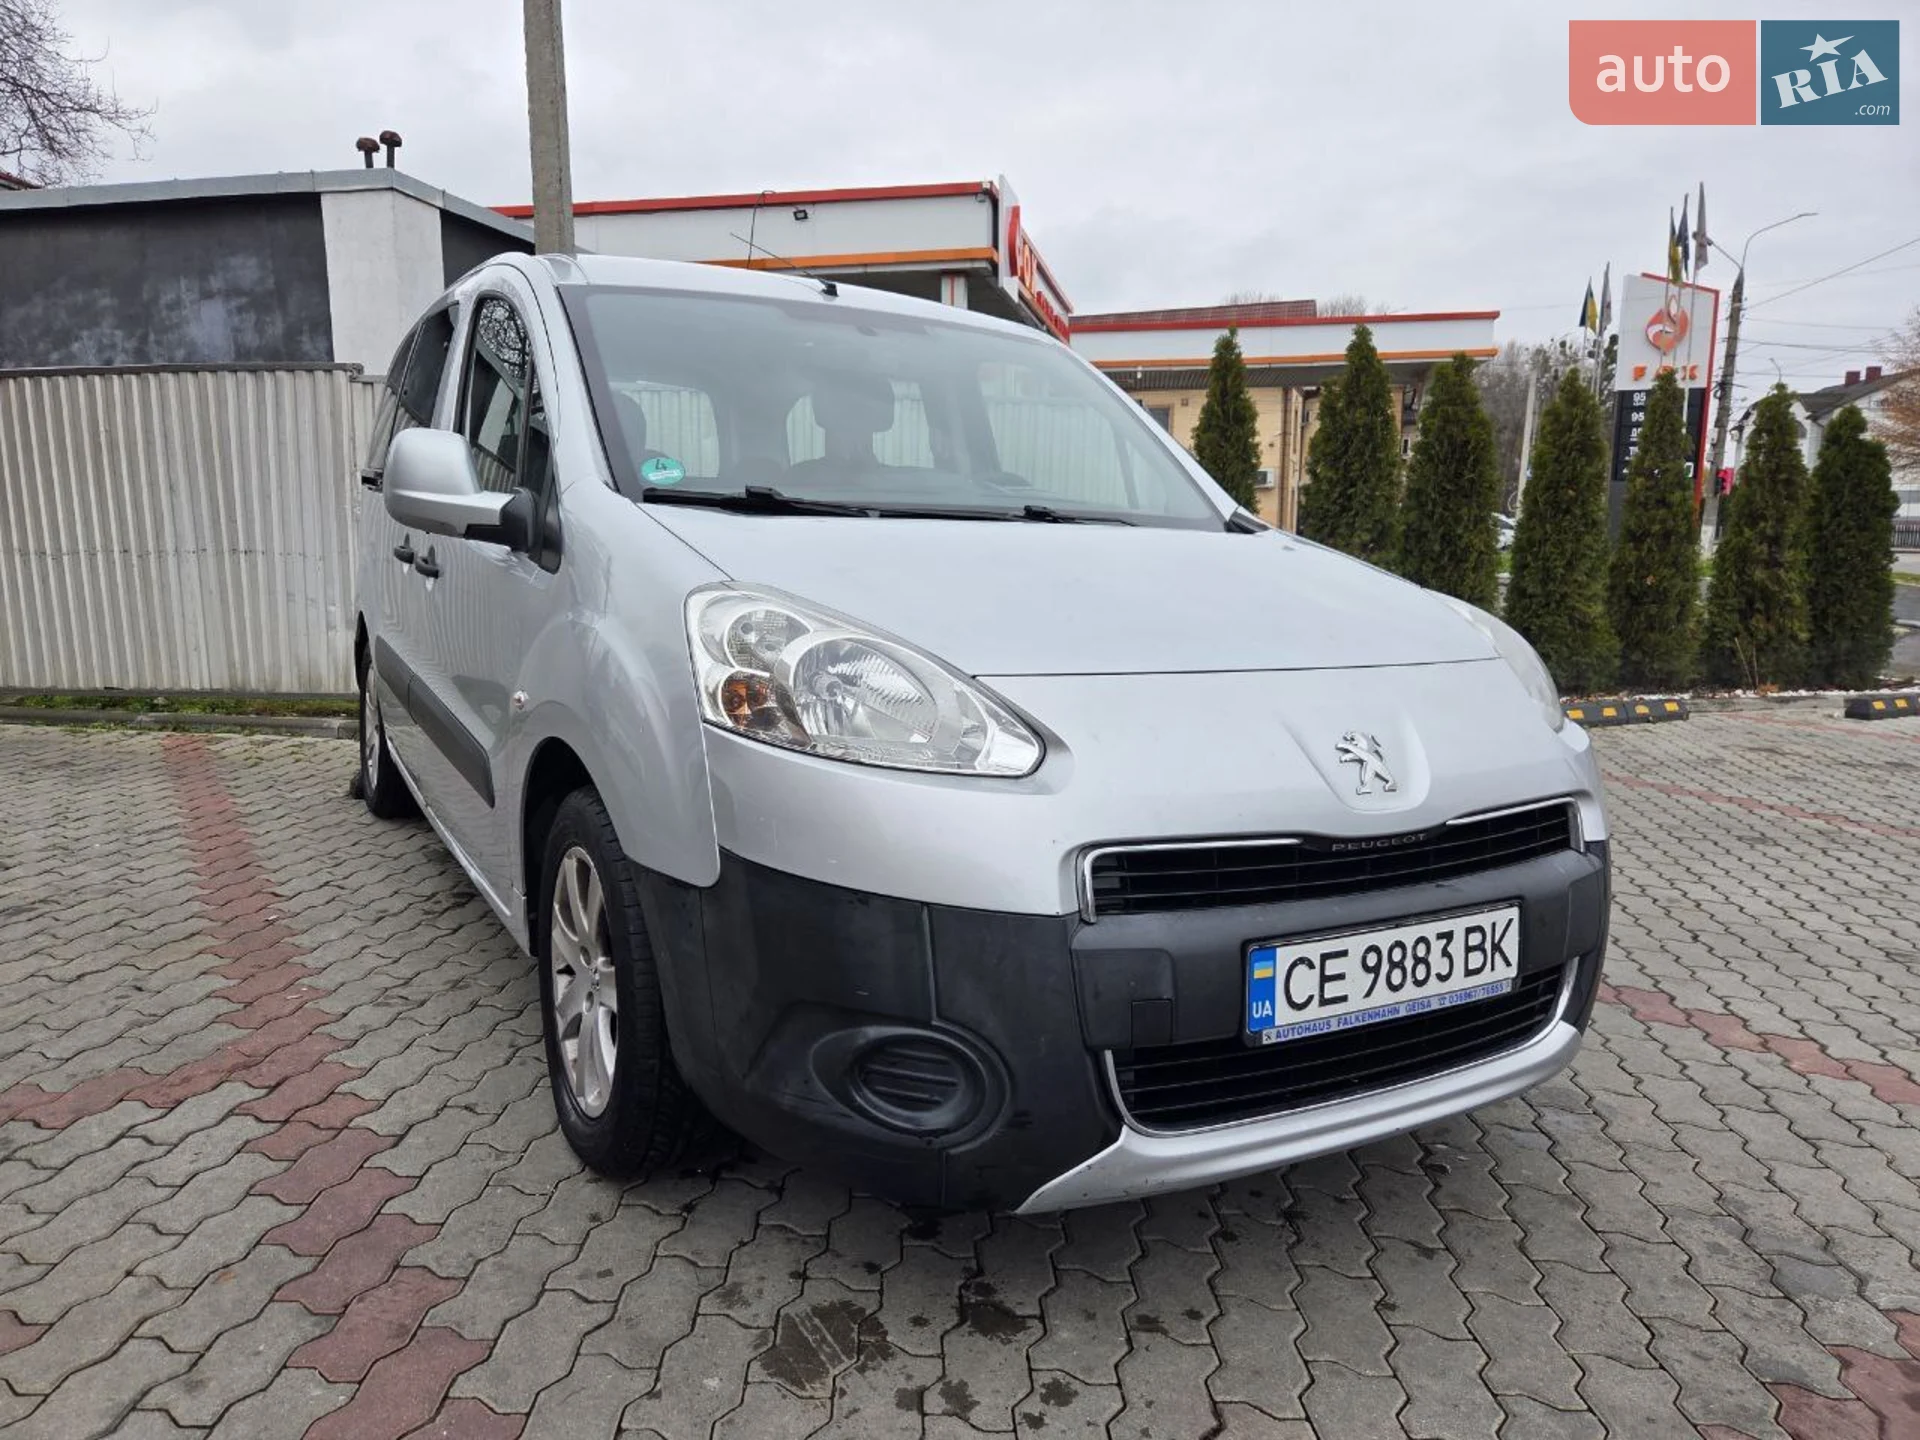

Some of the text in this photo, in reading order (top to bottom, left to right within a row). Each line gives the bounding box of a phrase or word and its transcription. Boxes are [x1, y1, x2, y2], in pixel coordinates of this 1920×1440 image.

[655, 458, 668, 471] 4
[1331, 833, 1428, 853] PEUGEOT
[1284, 917, 1515, 1012] CE 9883 BK
[1252, 1000, 1273, 1018] UA
[1275, 1019, 1332, 1041] AUTOHAUS
[1337, 1006, 1401, 1028] FALKENHAHN
[1405, 999, 1432, 1014] GEISA
